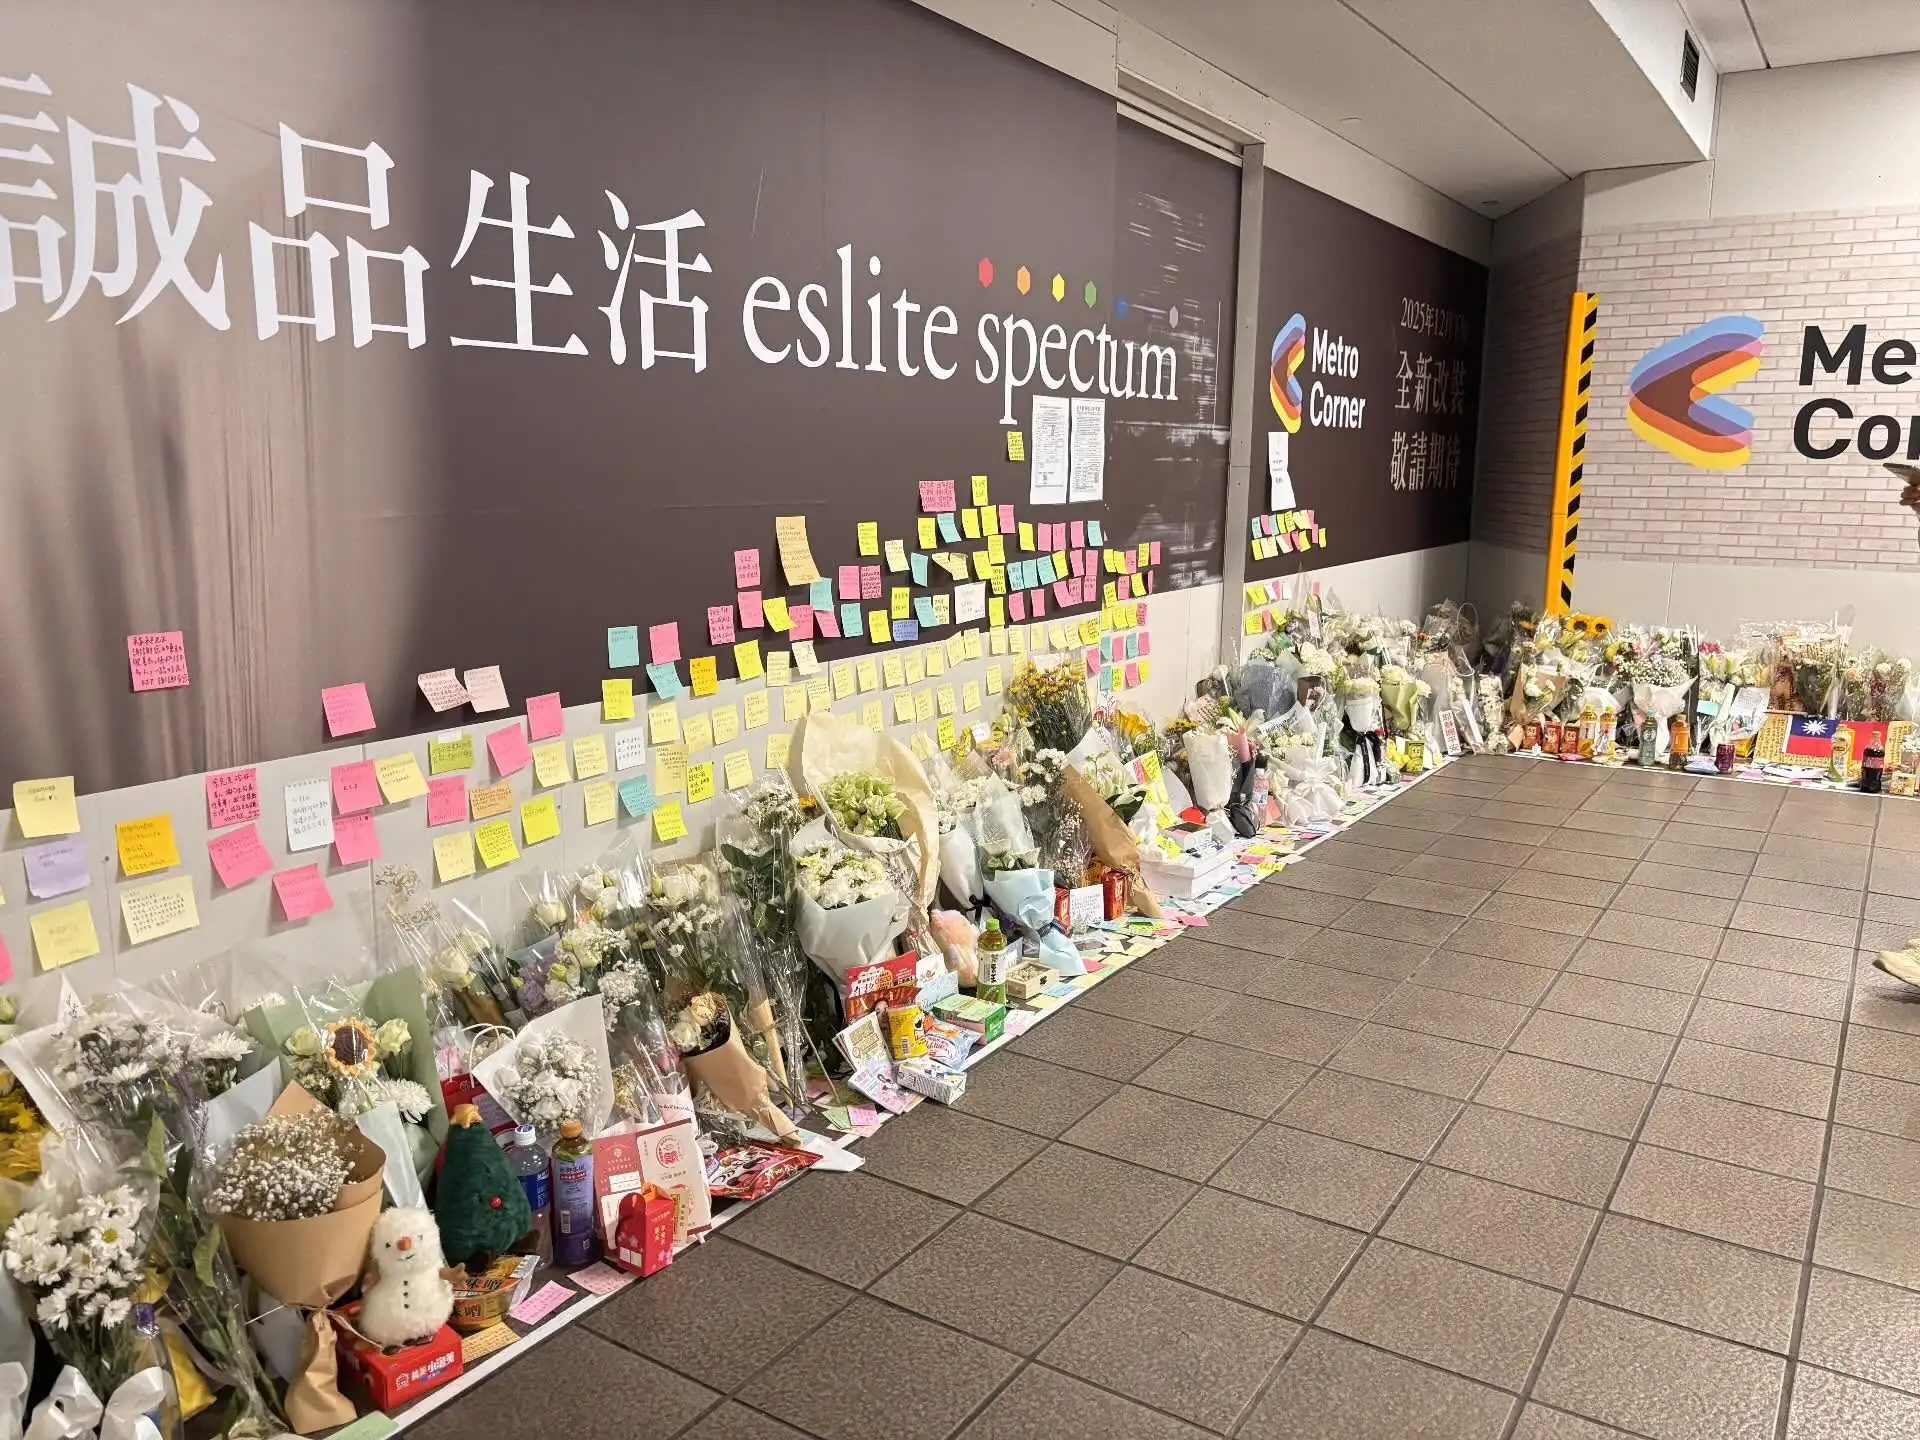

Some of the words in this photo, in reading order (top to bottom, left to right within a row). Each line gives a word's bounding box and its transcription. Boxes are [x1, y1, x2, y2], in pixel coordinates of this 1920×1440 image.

[0, 73, 713, 374] 誠品生活
[742, 243, 958, 380] eslite
[1312, 327, 1359, 379] Metro
[1395, 350, 1467, 416] 全新改裝
[1309, 380, 1367, 429] Corner
[1390, 431, 1460, 492] 敬請期待
